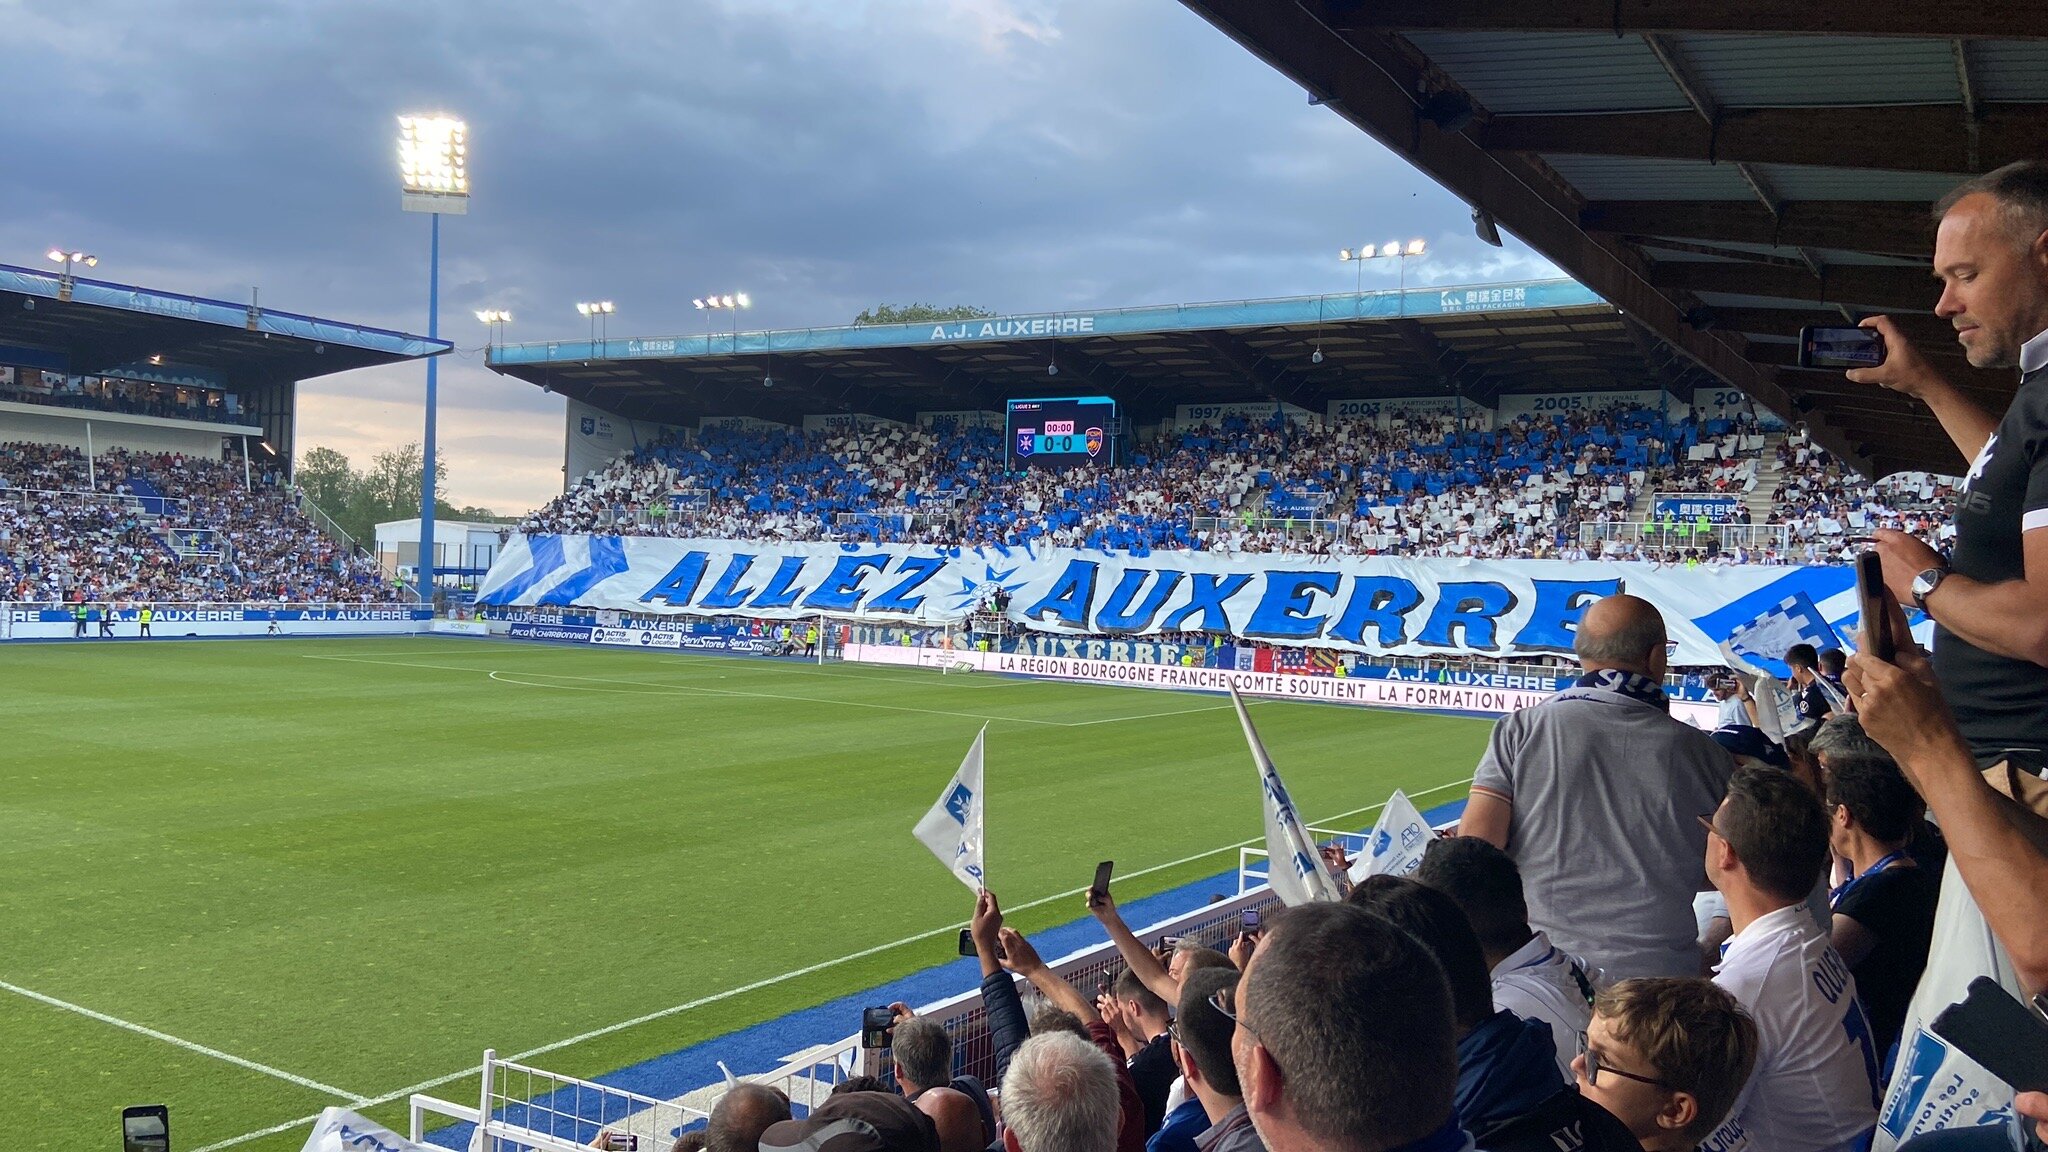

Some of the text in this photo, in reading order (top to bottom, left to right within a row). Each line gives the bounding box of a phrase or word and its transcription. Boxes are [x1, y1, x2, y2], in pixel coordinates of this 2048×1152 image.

[1483, 301, 1526, 310] PACKAGING
[930, 317, 1095, 340] A.J. AUXERRE
[1338, 402, 1381, 416] 2003
[1533, 396, 1581, 411] 2005
[1188, 407, 1222, 419] 1997
[1047, 424, 1072, 432] 00:00
[640, 551, 1626, 656] ALLEZ AUXERRE
[152, 610, 244, 621] AUXERRE
[299, 610, 411, 621] A.J. AUXERRE
[505, 612, 564, 625] AUXERRE
[629, 620, 694, 633] AUXERRE
[536, 630, 589, 640] CHARBONNIER
[1014, 632, 1180, 666] AUXERRE
[1385, 667, 1430, 682] A.J.
[1000, 657, 1015, 671] LA
[1020, 655, 1067, 675] RÉGION
[1072, 661, 1155, 682] BOURGOGNE
[1160, 669, 1226, 688] FRANCHE
[1234, 673, 1283, 692] COMTÉ
[1290, 678, 1366, 699] SOUTIENT
[1379, 685, 1398, 701] LA
[1406, 687, 1505, 709] FORMATION
